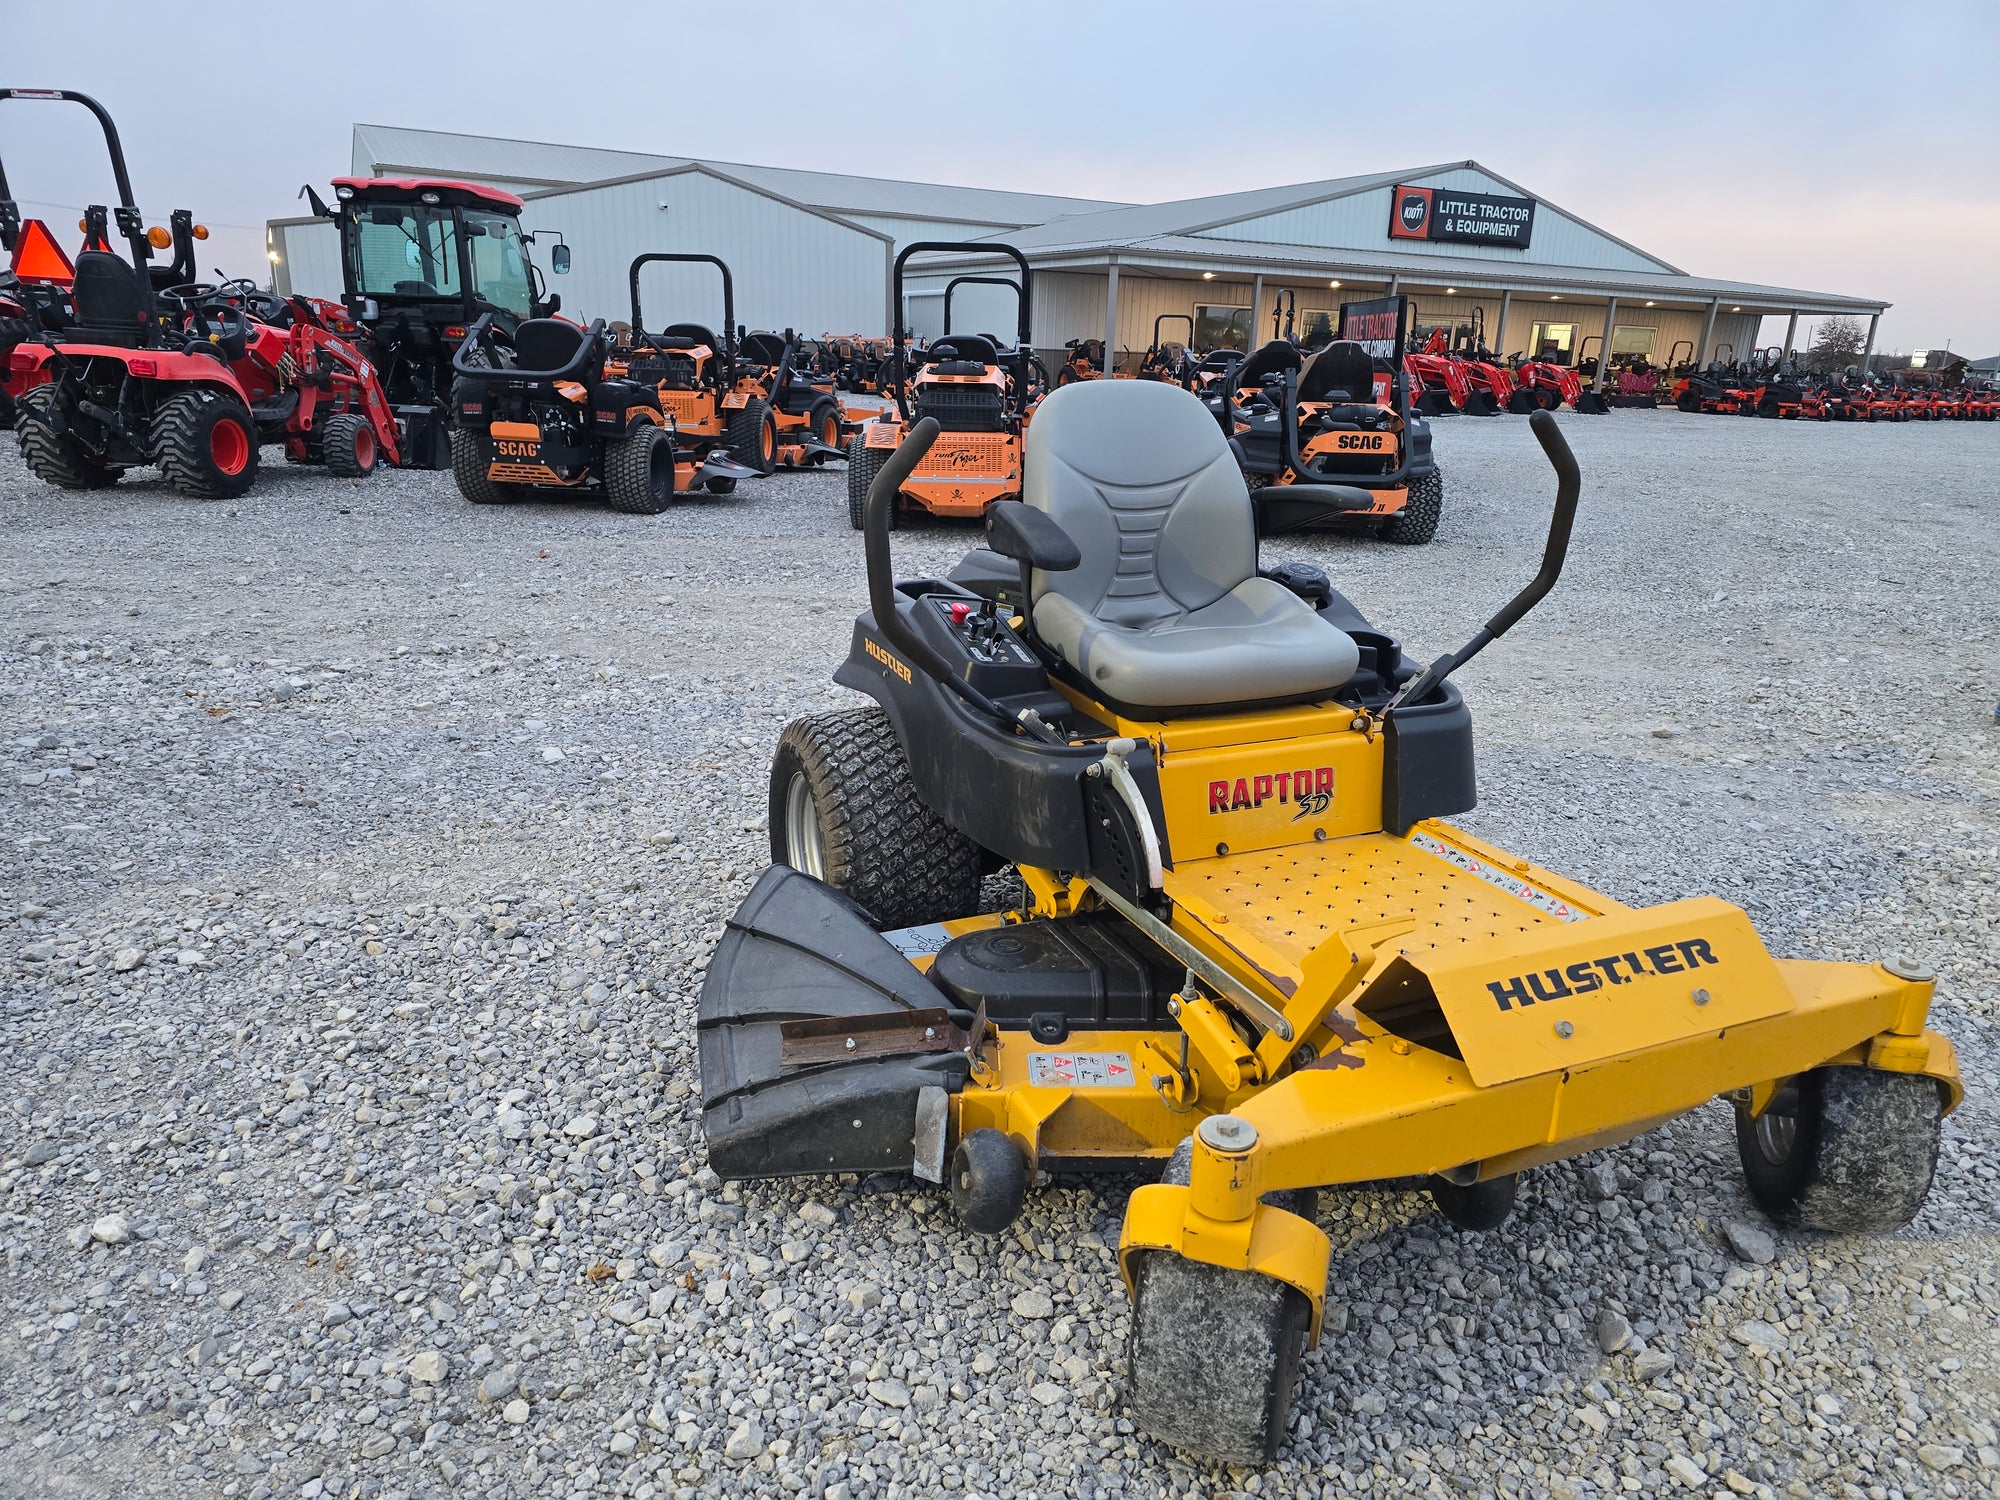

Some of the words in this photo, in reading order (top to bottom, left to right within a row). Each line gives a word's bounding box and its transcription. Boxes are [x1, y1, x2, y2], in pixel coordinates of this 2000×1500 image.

[1404, 202, 1424, 219] KIOTI
[1439, 201, 1477, 216] LITTLE
[1480, 204, 1529, 221] TRACTOR
[1445, 218, 1453, 231] &
[1457, 219, 1520, 237] EQUIPMENT
[1343, 316, 1365, 340] LITTLE
[499, 441, 537, 457] SCAG
[1338, 435, 1383, 450] SCAG
[951, 450, 979, 467] Tiger
[864, 637, 912, 685] HUSTLER
[1208, 766, 1335, 814] RAPTOR
[1291, 793, 1330, 822] SD
[1485, 938, 1719, 1012] HUSTLER
